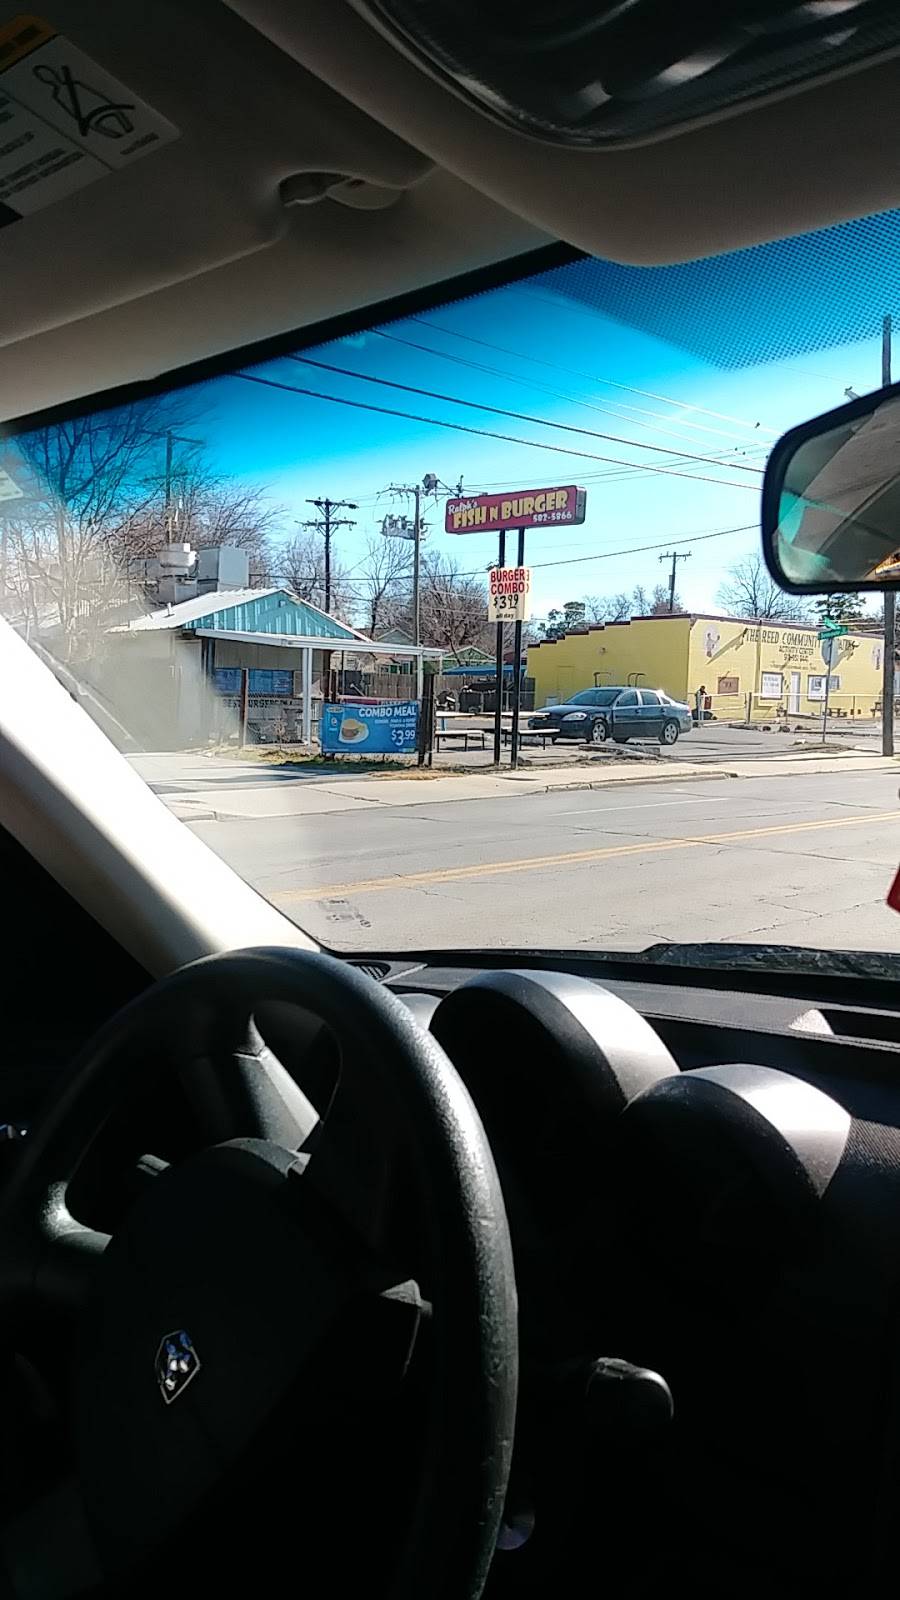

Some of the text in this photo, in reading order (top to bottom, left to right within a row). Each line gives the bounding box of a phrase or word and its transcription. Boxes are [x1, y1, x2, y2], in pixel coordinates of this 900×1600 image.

[448, 500, 477, 515] Ralph's
[453, 490, 569, 529] FISH N BURGER
[490, 569, 526, 583] BURGER
[490, 582, 525, 595] COMBO
[745, 628, 760, 642] THE
[761, 629, 780, 644] REED
[358, 706, 417, 718] COMBO MEAL
[391, 729, 416, 746] $3.99
